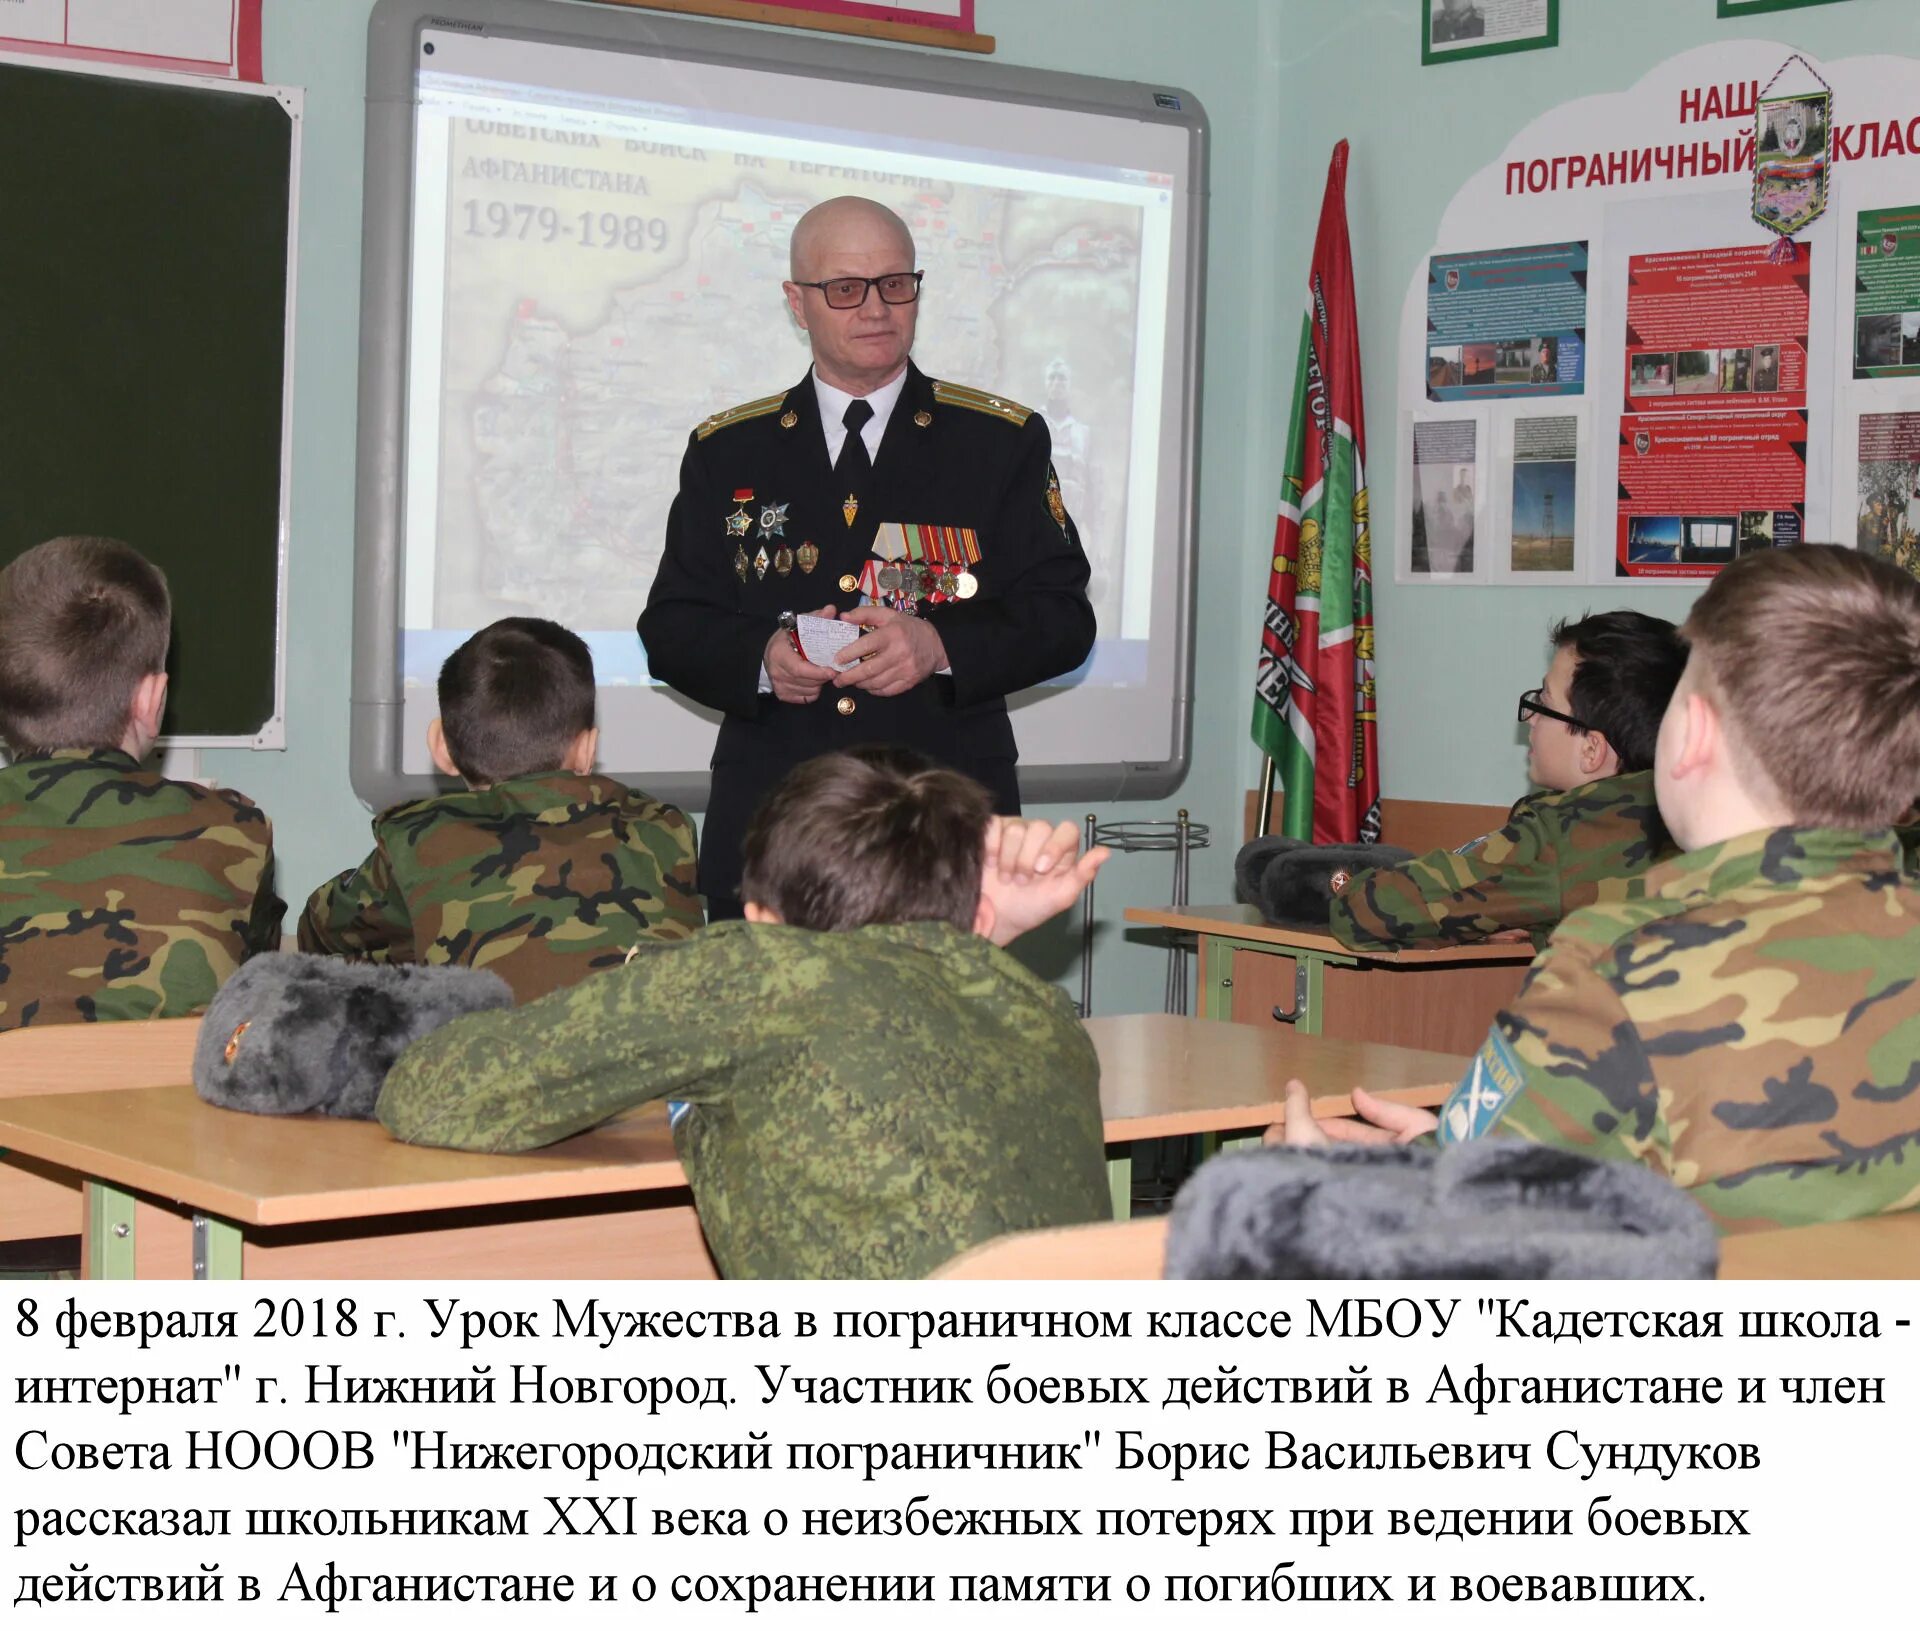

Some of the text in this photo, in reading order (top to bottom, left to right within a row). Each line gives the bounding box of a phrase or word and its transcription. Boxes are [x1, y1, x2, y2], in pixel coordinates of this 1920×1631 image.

[1680, 80, 1758, 124] НАШ
[461, 155, 651, 197] АФГАНИСТАНА
[1505, 115, 1920, 196] ПОГРАНИЧНЫЙ КЛАС
[463, 198, 669, 255] 1979-1989
